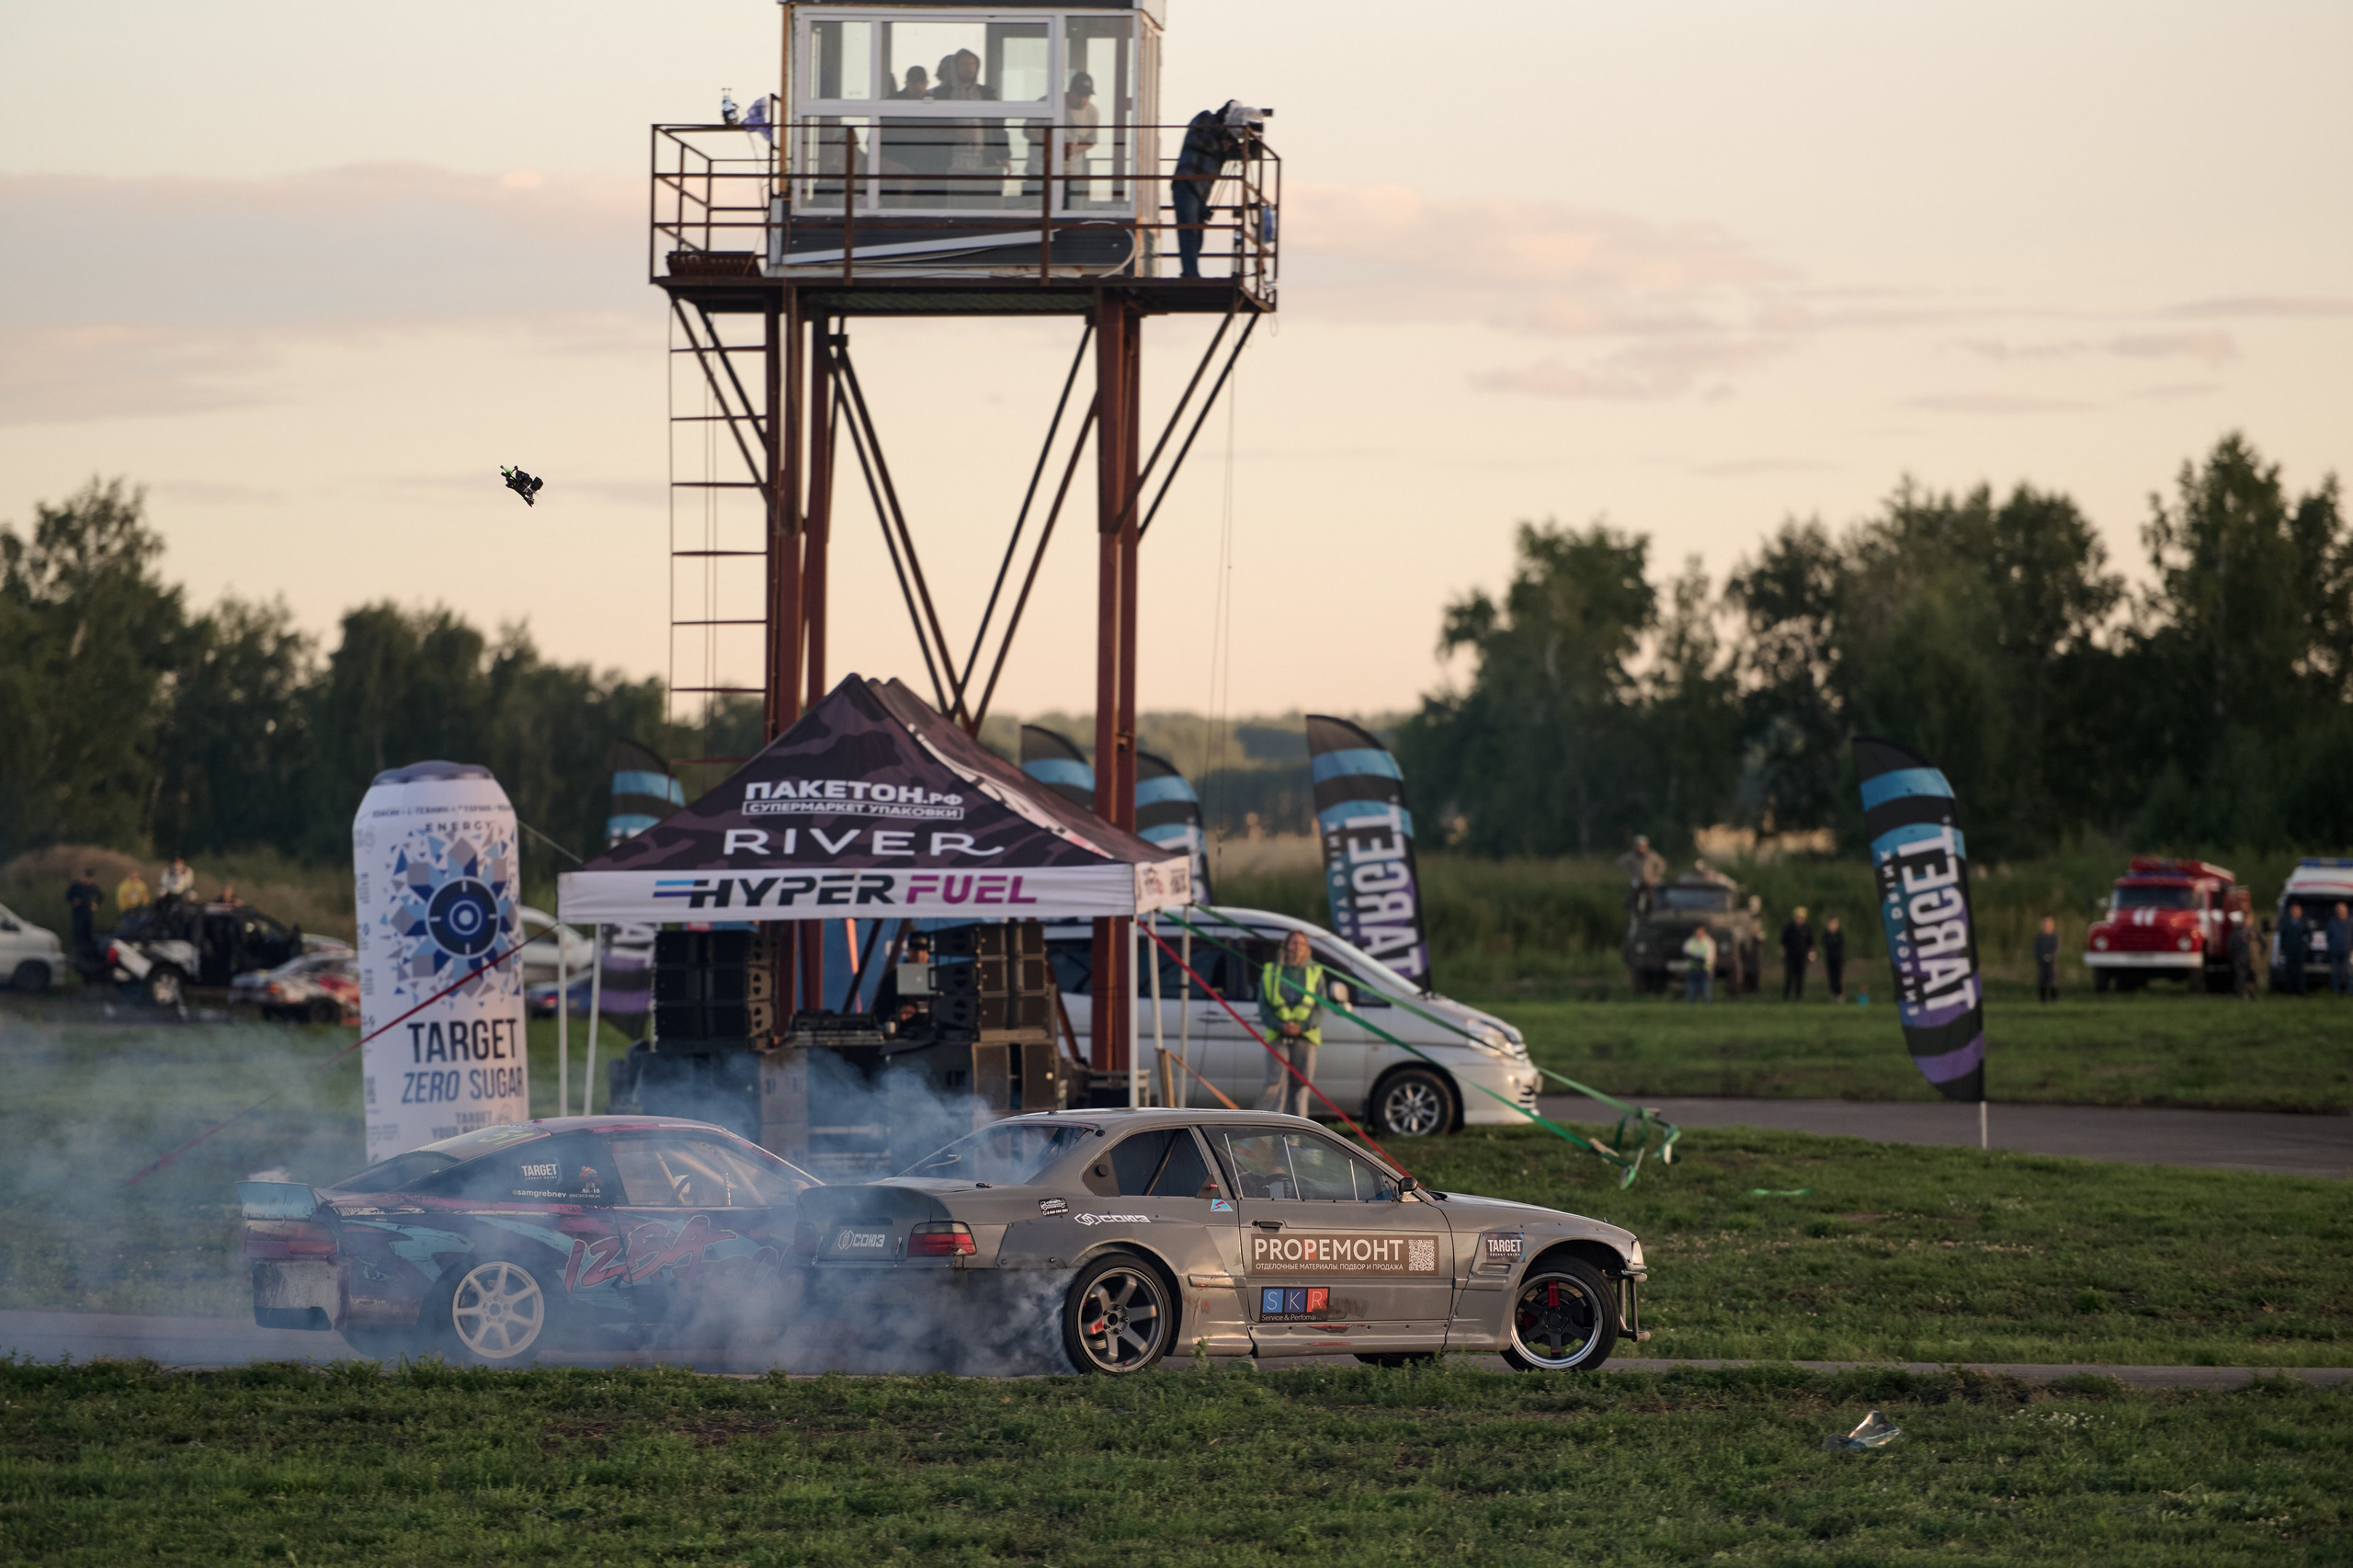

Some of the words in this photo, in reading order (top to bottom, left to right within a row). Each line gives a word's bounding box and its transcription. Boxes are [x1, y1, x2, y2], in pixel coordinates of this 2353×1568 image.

[745, 779, 964, 806] ПАКЕТОН.РФ
[749, 802, 866, 813] СУПЕРМАРКЕТ
[868, 804, 958, 817] УПАКОВКИ
[425, 820, 493, 834] ENERGY
[723, 828, 1006, 857] RIVER
[653, 875, 896, 908] HYPER
[905, 874, 1038, 905] FUEL
[406, 1017, 518, 1064] TARGET
[401, 1070, 460, 1104] ZERO
[470, 1066, 524, 1102] SUGAR
[521, 1164, 557, 1177] TARGET
[1487, 1239, 1522, 1253] TARGET
[1256, 1263, 1299, 1271] ОТДЕЛОЧНЫЕ
[1339, 1263, 1366, 1271] ПОДБОР
[1372, 1263, 1404, 1271] ПРОДАЖА
[1261, 1313, 1284, 1322] Service
